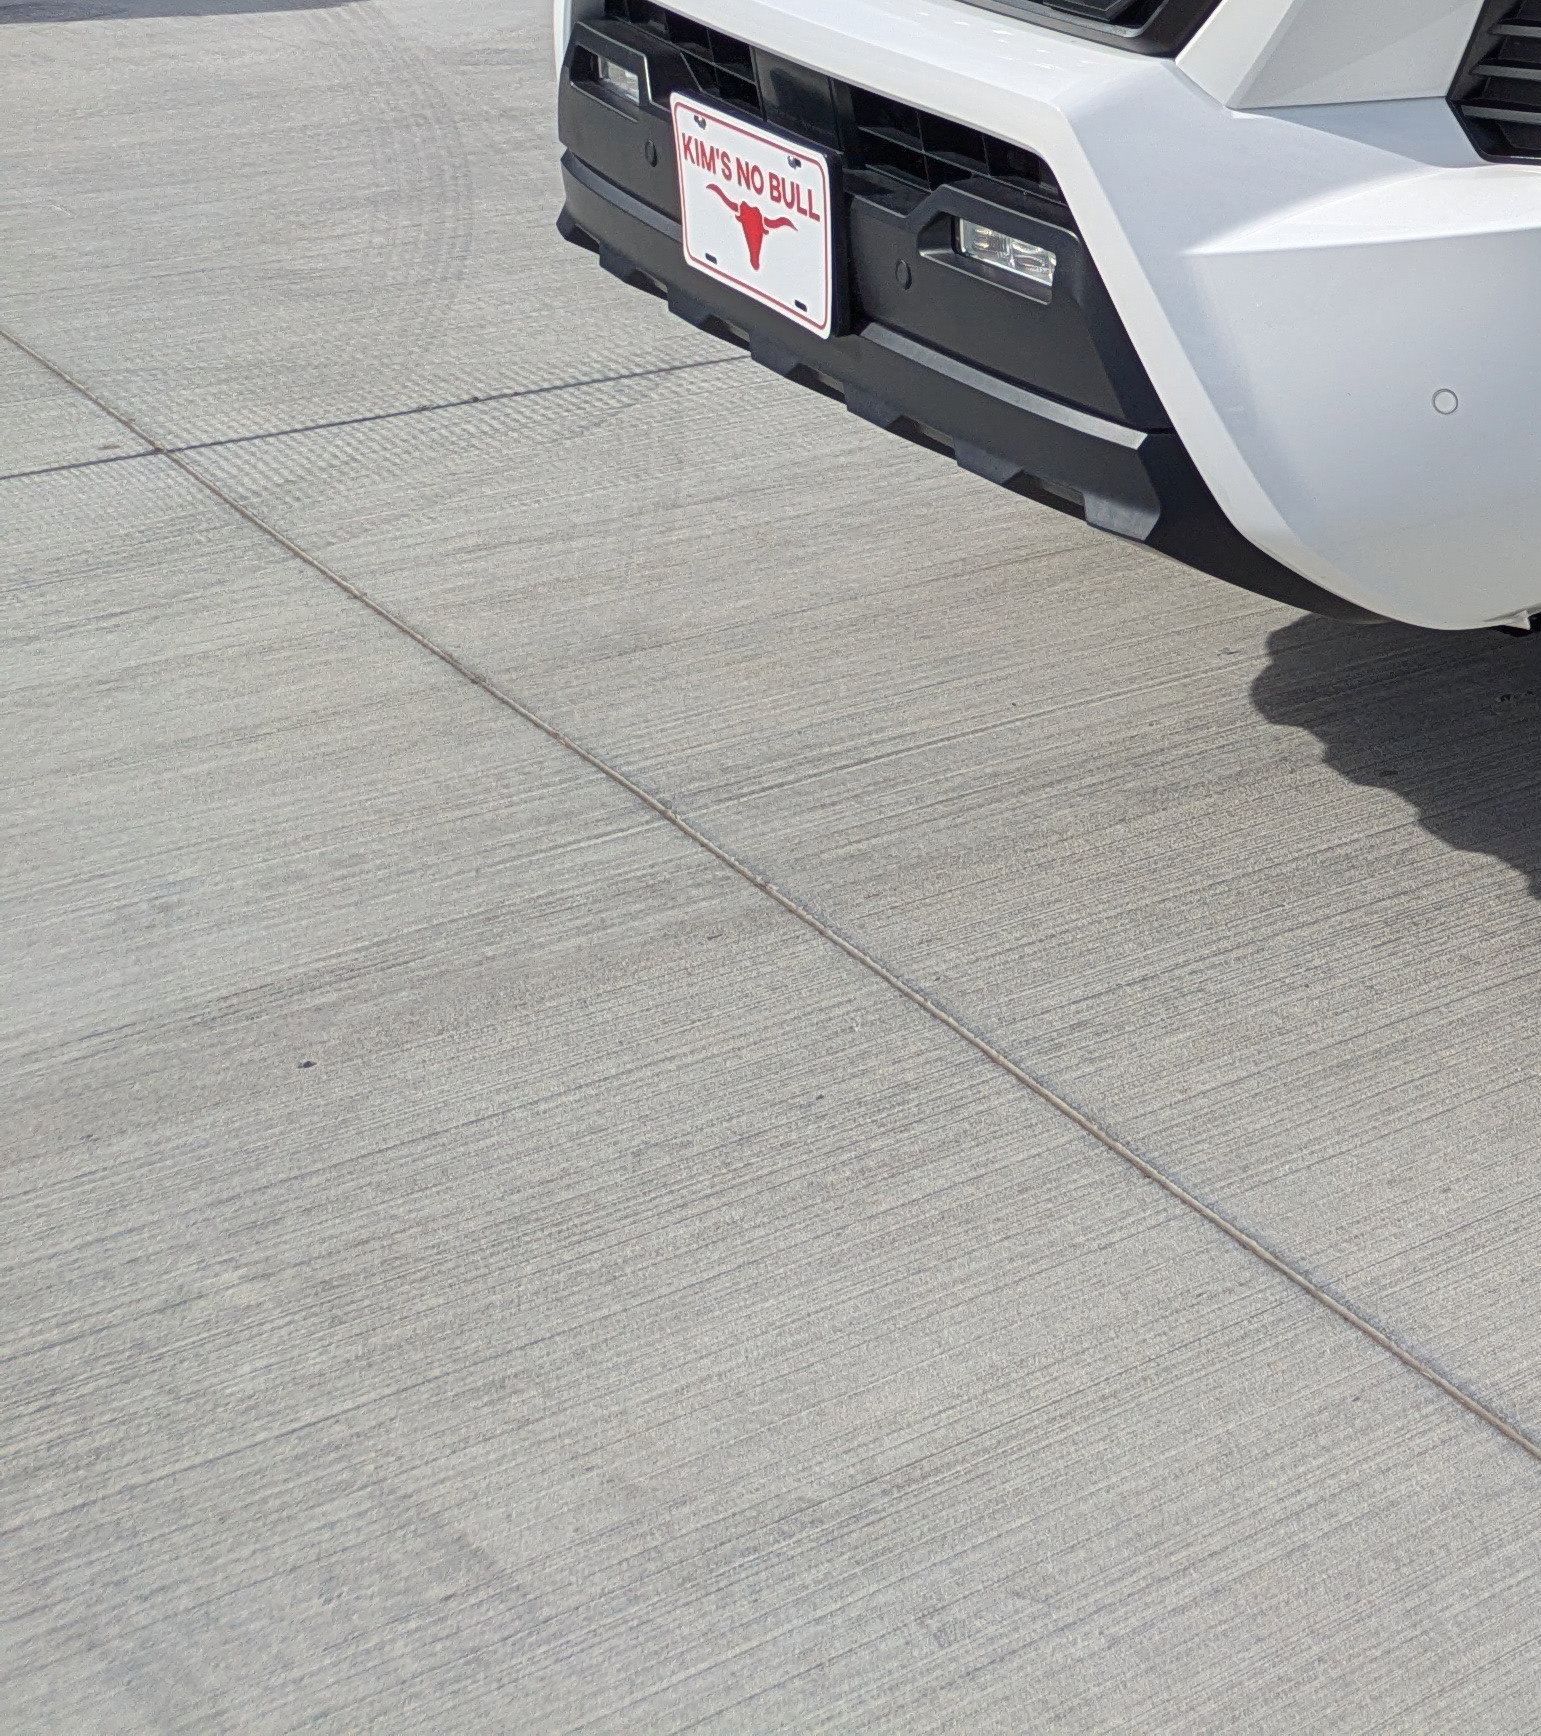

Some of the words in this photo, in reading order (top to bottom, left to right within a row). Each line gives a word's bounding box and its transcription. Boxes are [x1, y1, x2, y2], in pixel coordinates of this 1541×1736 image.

[682, 133, 732, 181] KIM'S
[735, 157, 764, 196] NO
[768, 172, 821, 222] BULL
